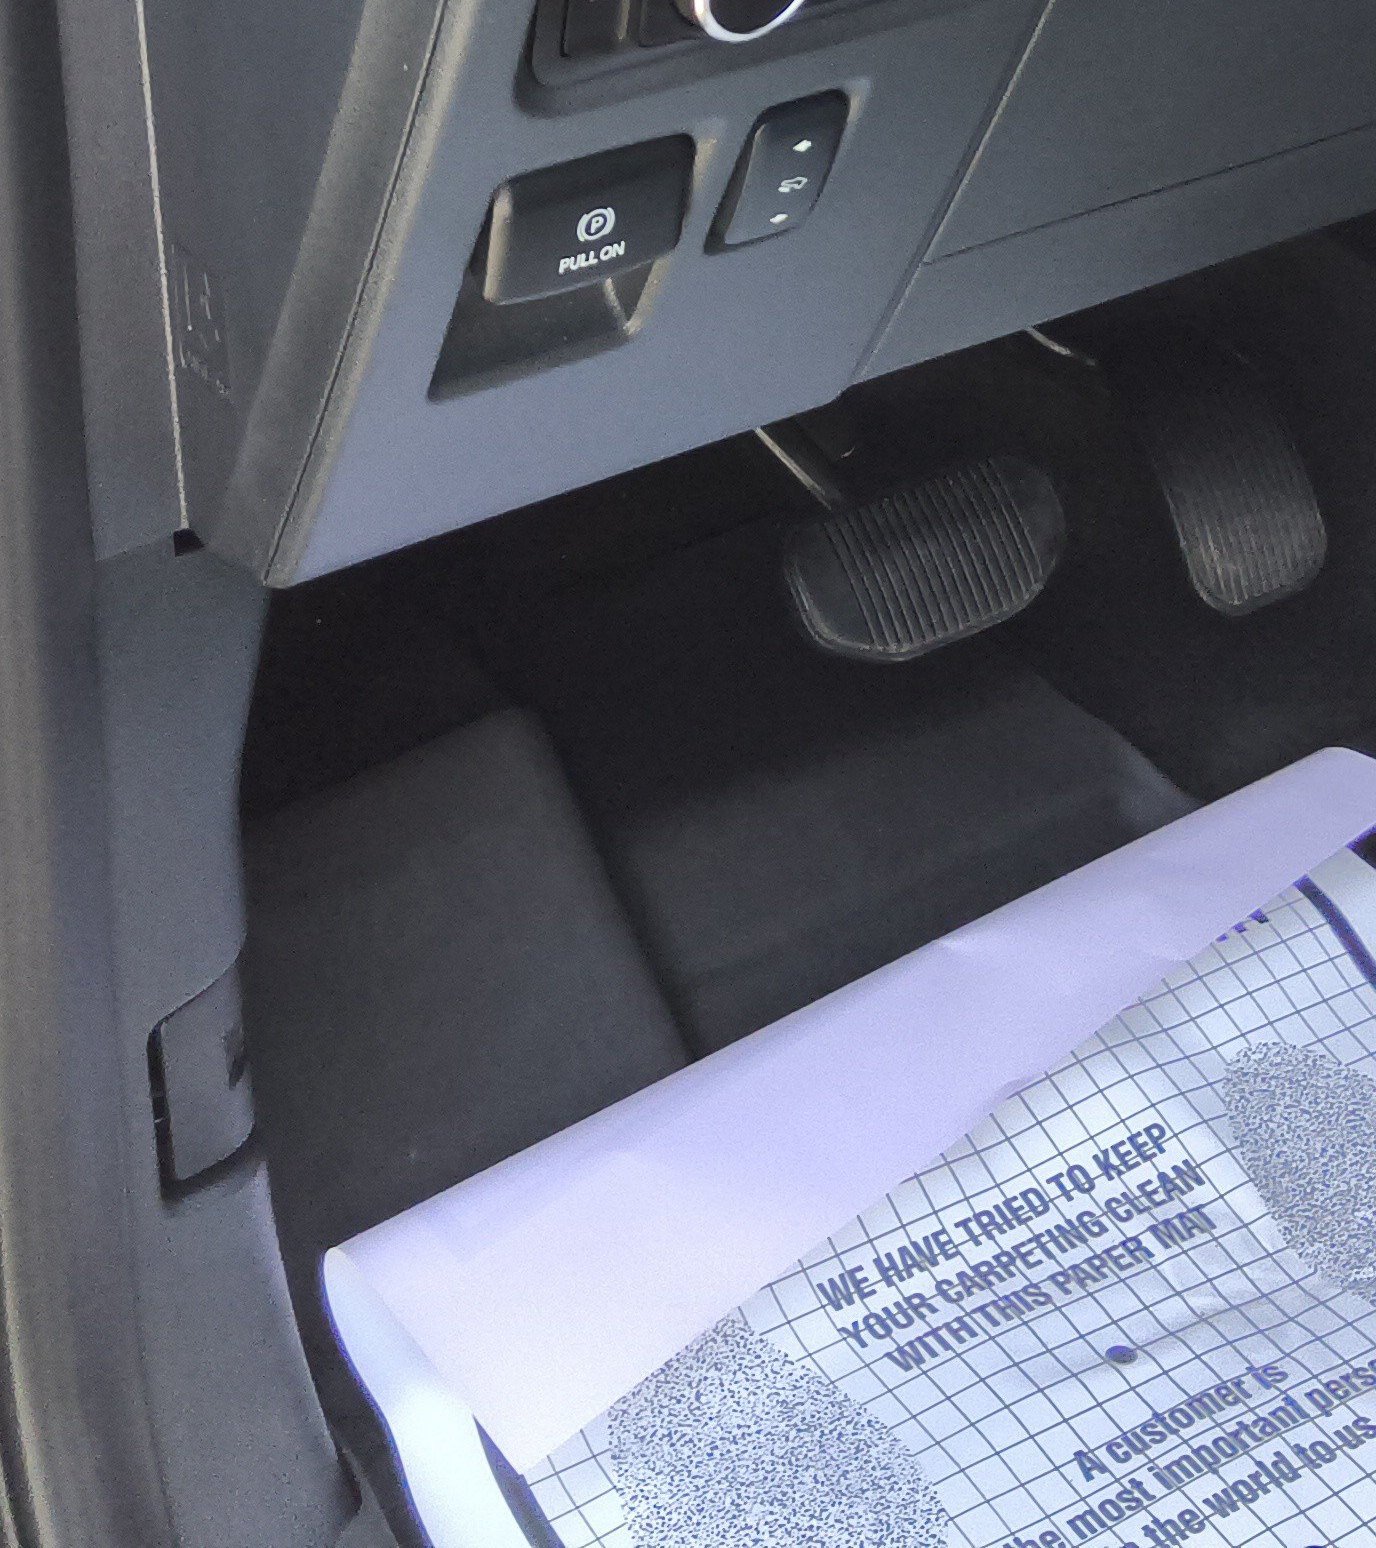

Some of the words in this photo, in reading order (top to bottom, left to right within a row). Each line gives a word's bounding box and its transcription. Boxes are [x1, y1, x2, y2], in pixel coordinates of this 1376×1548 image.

[559, 250, 599, 274] PULL
[599, 240, 626, 261] ON
[816, 1265, 877, 1312] WE
[873, 1228, 957, 1288] HAVE
[954, 1187, 1051, 1246] TRIED
[1046, 1164, 1096, 1202] TO
[1092, 1122, 1168, 1181] KEEP
[838, 1292, 939, 1349] YOUR
[935, 1210, 1109, 1305] CARPETING
[1105, 1158, 1206, 1224] CLEAN
[886, 1315, 979, 1373] WITH
[975, 1282, 1053, 1328] THIS
[1050, 1235, 1156, 1295] PAPER
[1148, 1203, 1218, 1250] MAT
[1067, 1477, 1157, 1540] most
[1147, 1395, 1311, 1490] important
[1073, 1449, 1107, 1482] A
[1105, 1378, 1253, 1464] customer
[1246, 1362, 1290, 1391] is
[1141, 1507, 1206, 1548] the
[1203, 1452, 1301, 1518] world
[1292, 1439, 1338, 1470] to
